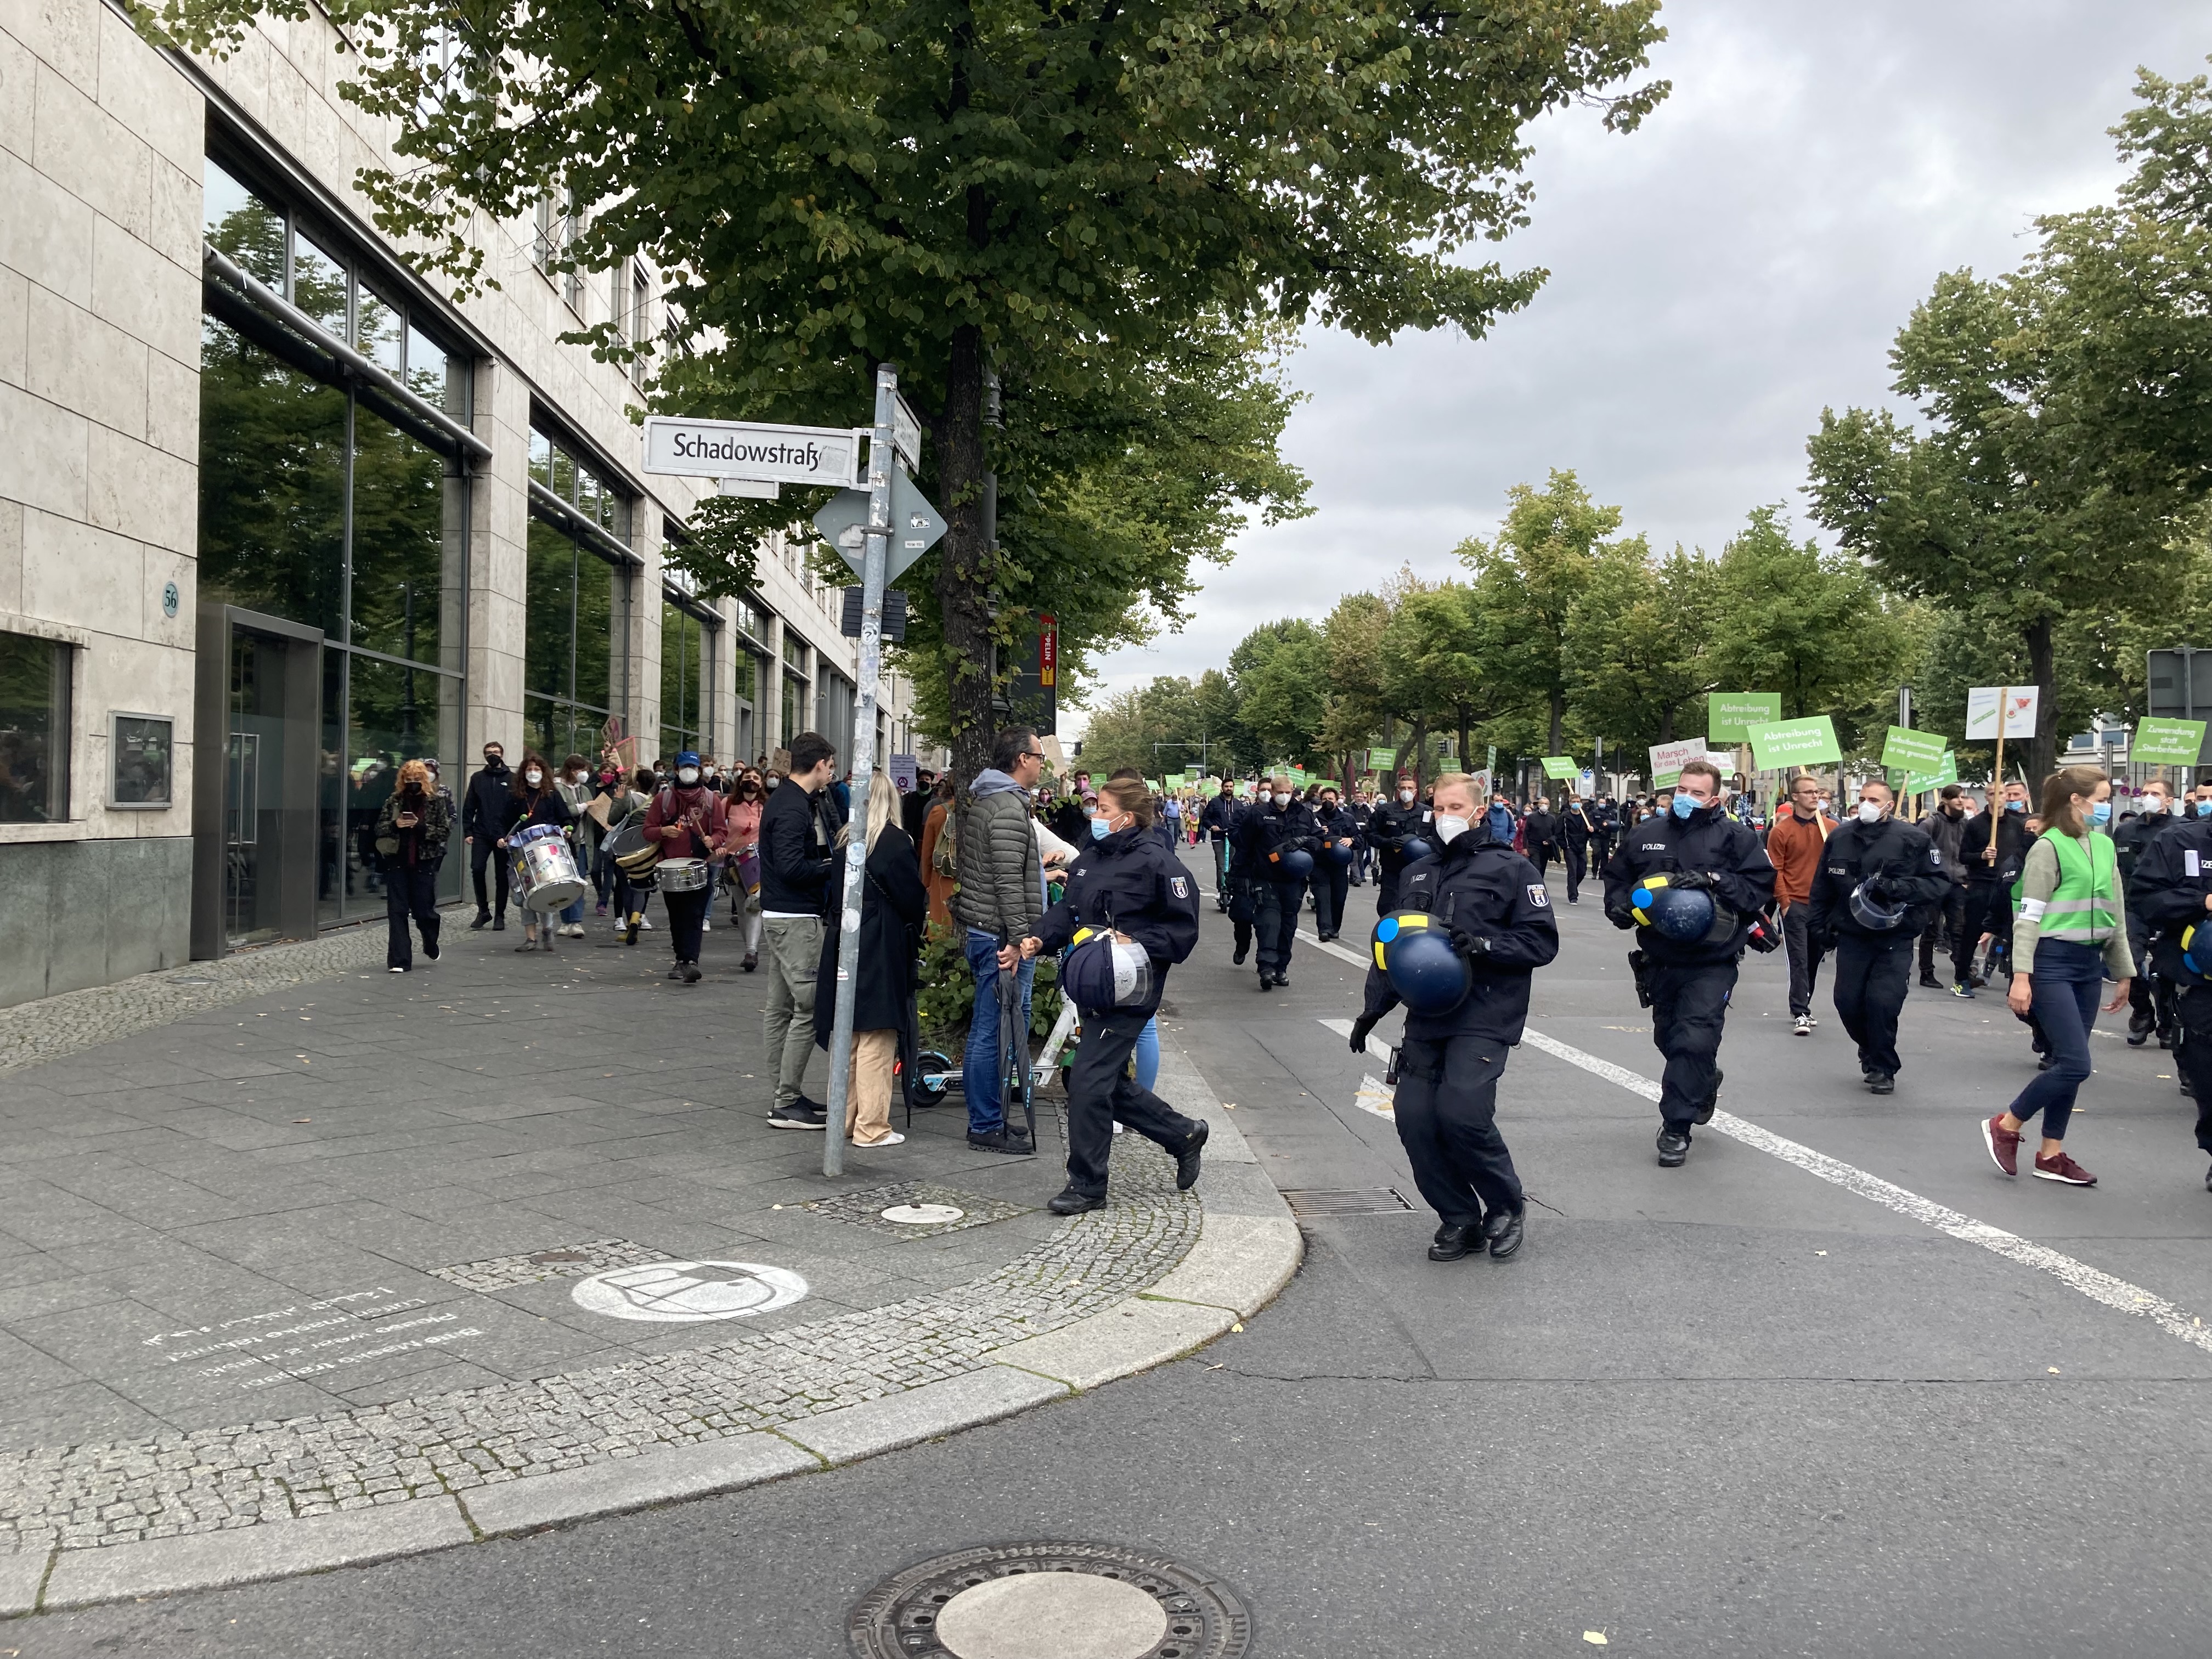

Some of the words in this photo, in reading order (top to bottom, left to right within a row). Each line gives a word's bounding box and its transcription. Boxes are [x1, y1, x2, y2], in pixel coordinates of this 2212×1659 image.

[673, 433, 822, 472] Schadowstraß
[165, 590, 177, 609] 56
[1720, 703, 1770, 715] Abtreibung
[1722, 716, 1732, 726] ist
[1734, 716, 1769, 725] Unrecht
[1764, 728, 1822, 741] Abtreibung
[1768, 744, 1780, 753] ist
[1783, 738, 1823, 751] Unrecht
[1657, 747, 1689, 760] Marsch
[1906, 751, 1939, 762] grenzenlos
[1678, 755, 1705, 766] Leben
[1909, 777, 1920, 785] not
[266, 1316, 348, 1339] maske
[375, 1313, 458, 1334] Please
[310, 1332, 371, 1350] wear
[284, 1347, 303, 1356] a
[338, 1340, 422, 1364] Maske
